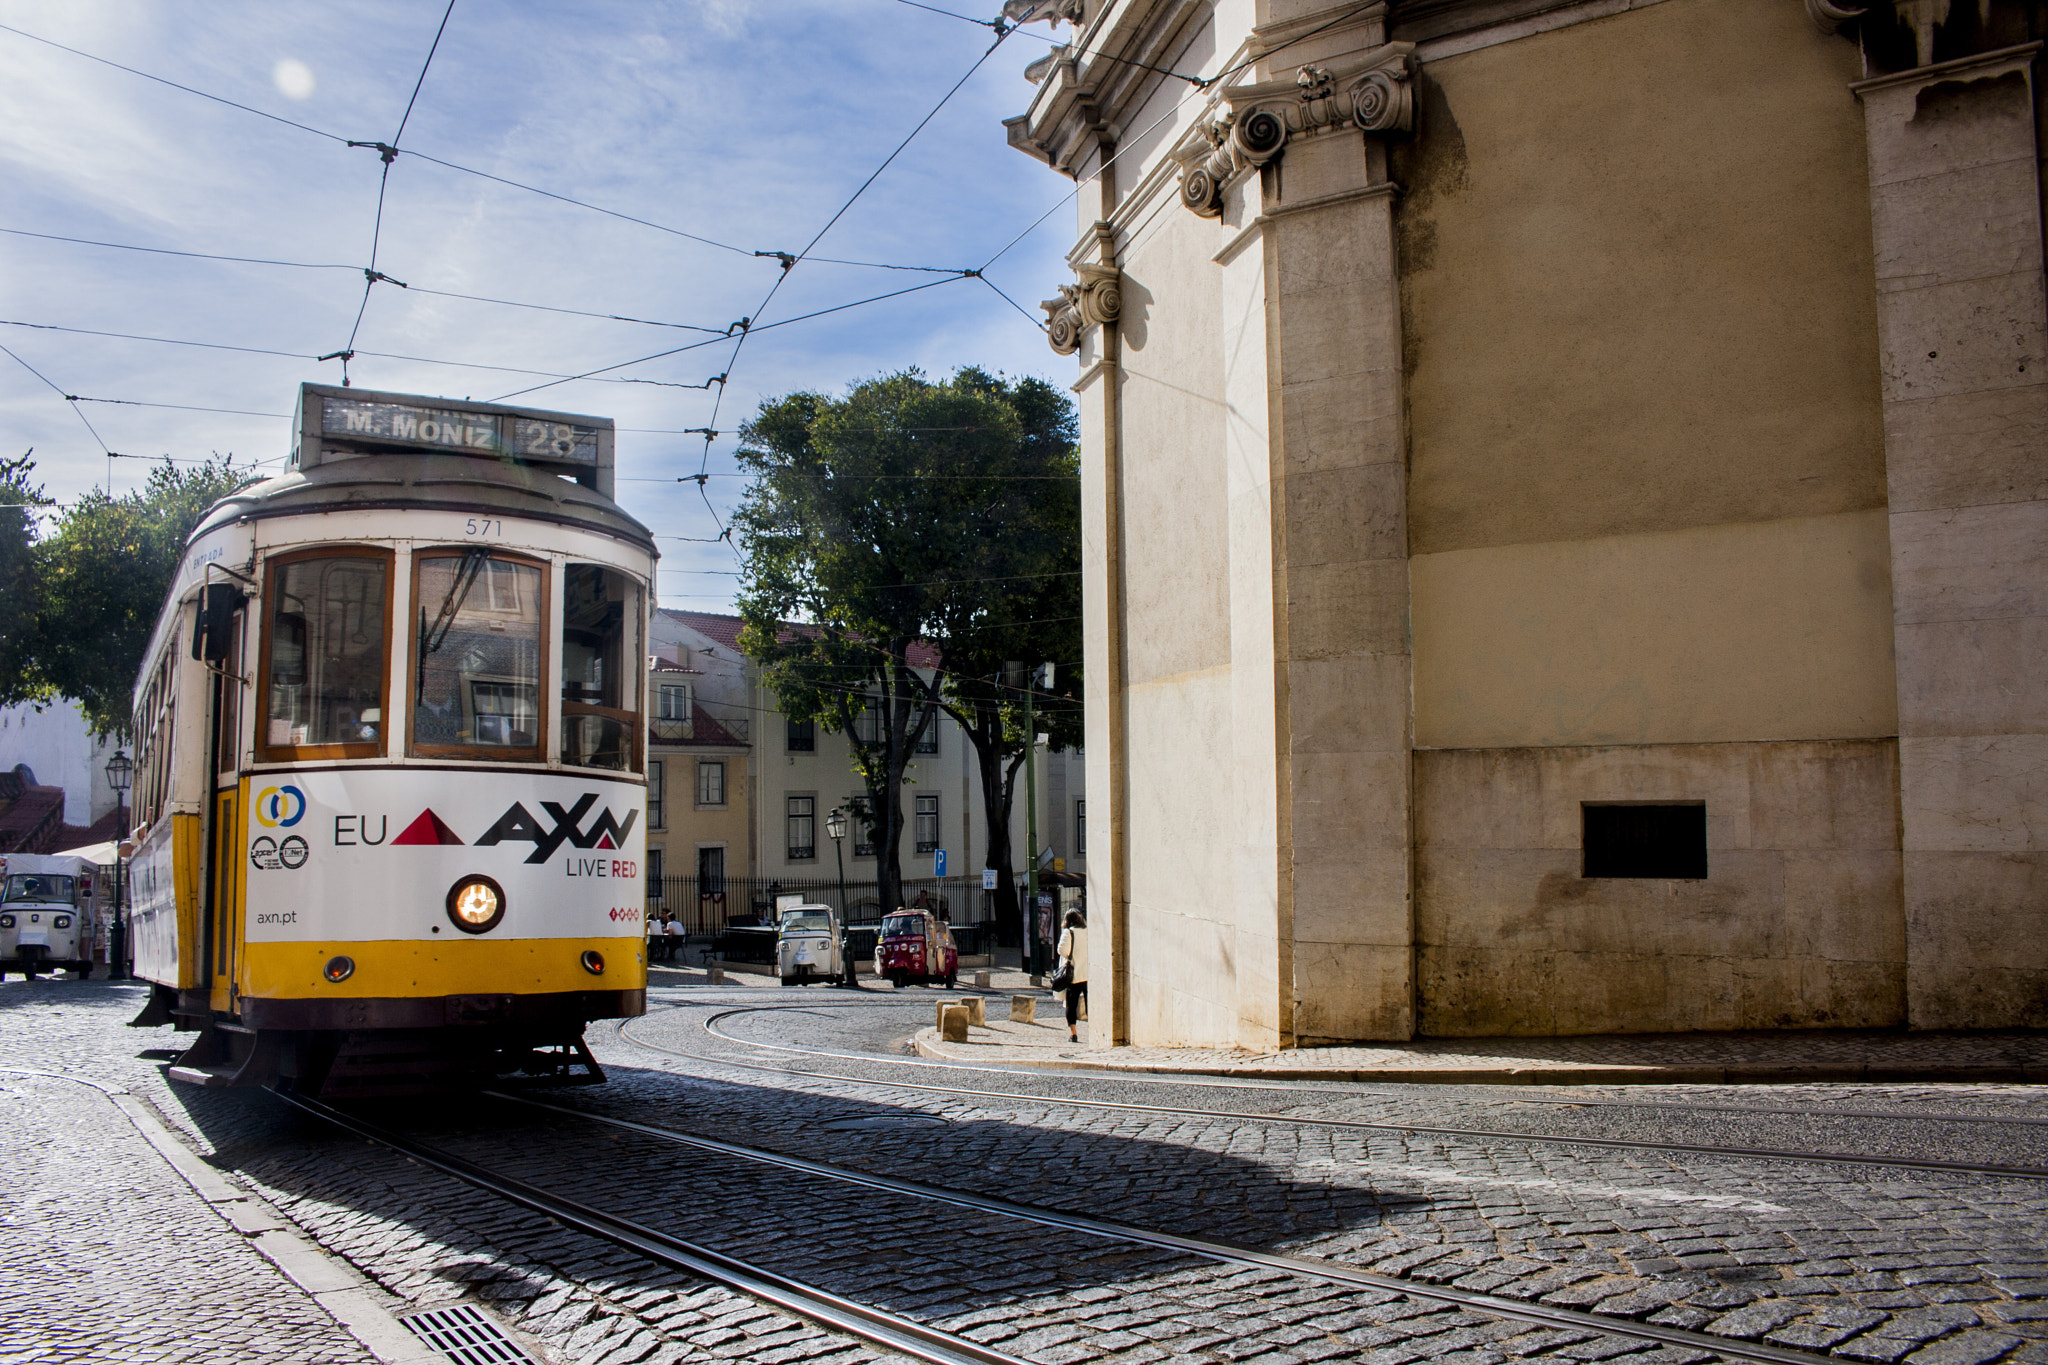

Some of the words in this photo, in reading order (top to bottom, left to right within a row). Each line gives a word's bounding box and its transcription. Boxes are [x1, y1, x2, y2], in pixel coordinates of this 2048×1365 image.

[346, 409, 381, 434] M.
[392, 413, 495, 449] MONIZ
[526, 423, 575, 457] 28
[465, 518, 501, 537] 571
[193, 546, 223, 570] ENTRADA
[334, 814, 387, 846] EU
[473, 792, 639, 865] AXN
[566, 858, 607, 877] LIVE
[612, 860, 637, 878] RED
[937, 851, 944, 870] P
[1025, 894, 1053, 905] TENIS
[257, 910, 297, 926] axn.pt
